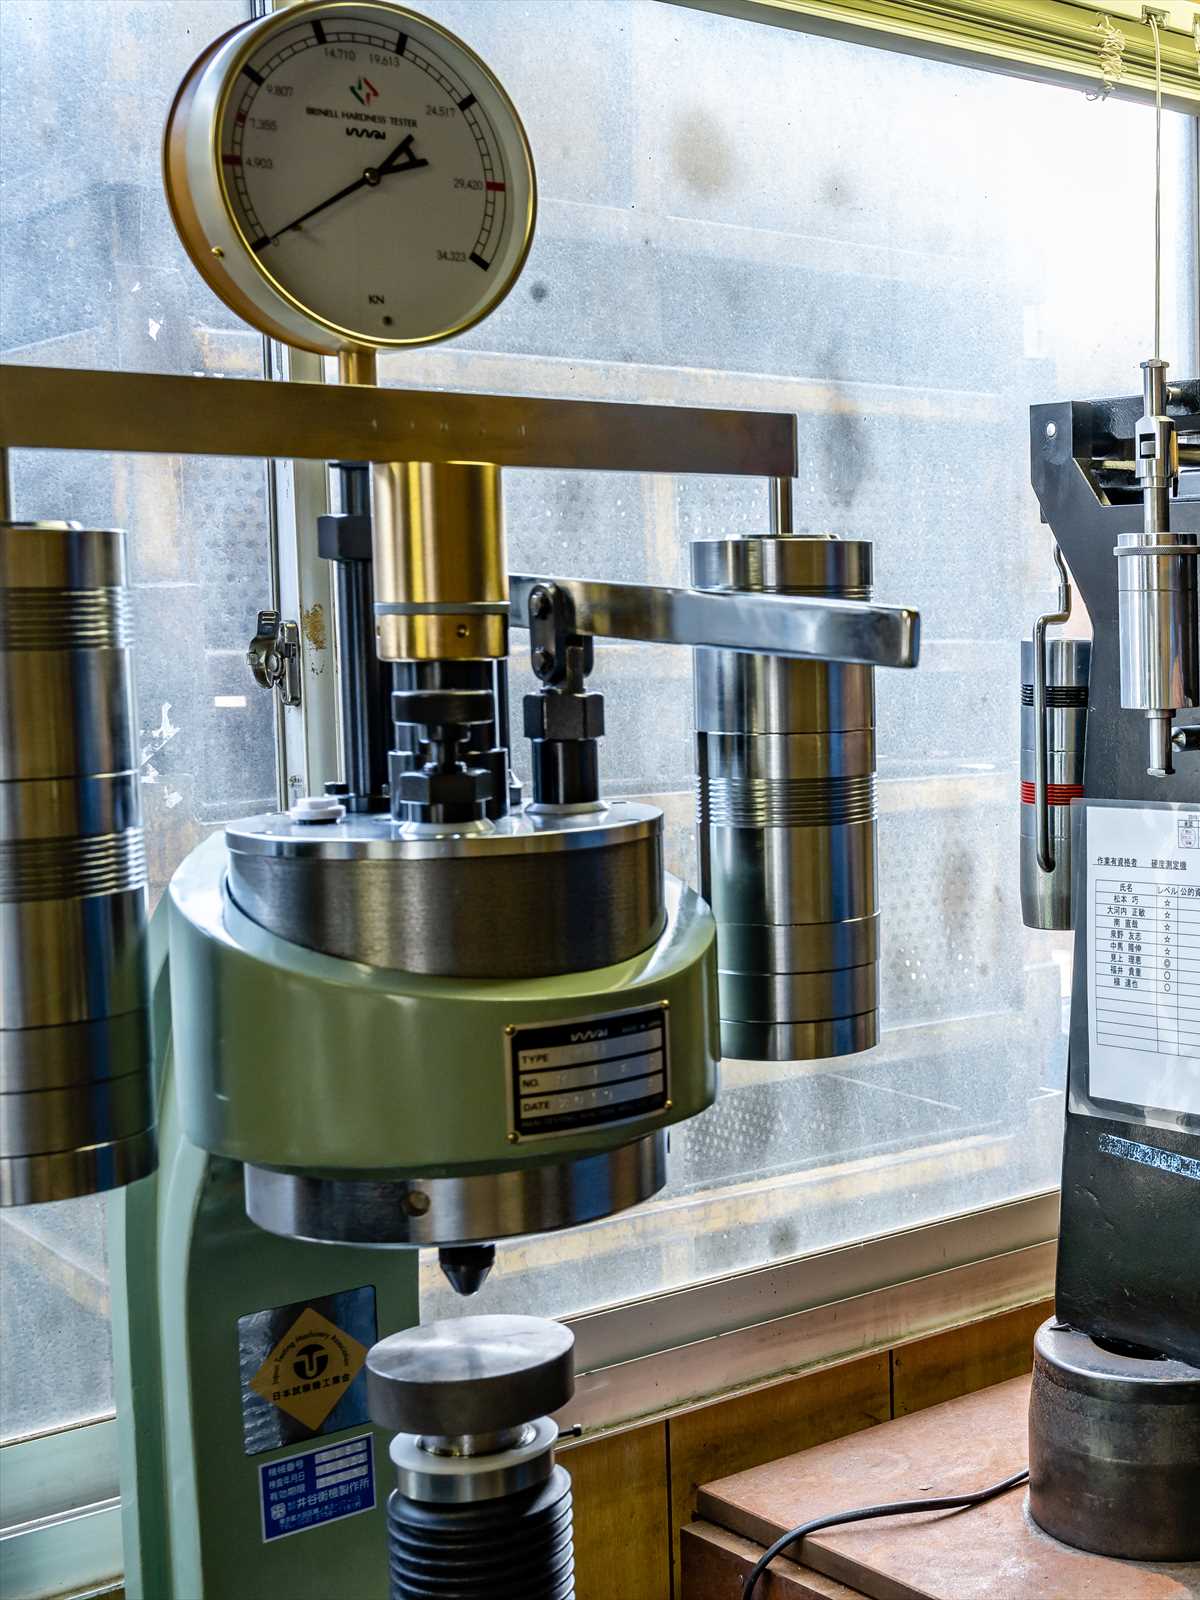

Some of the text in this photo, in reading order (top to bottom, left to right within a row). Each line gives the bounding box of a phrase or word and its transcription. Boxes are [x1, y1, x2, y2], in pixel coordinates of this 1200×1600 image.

[324, 48, 356, 62] 14.710
[369, 53, 400, 67] 19.613
[266, 84, 294, 98] 9.807
[425, 105, 457, 119] 24.517
[341, 110, 388, 125] HARDNESS
[390, 116, 418, 129] TESTER
[245, 158, 273, 170] 4.903
[453, 178, 484, 191] 29.420
[436, 250, 467, 263] 34.323
[368, 294, 385, 305] KN
[1097, 856, 1188, 871] 作業有資格者 硬度測定機
[1119, 883, 1133, 893] 氏名
[1158, 887, 1178, 895] レベル
[1113, 895, 1127, 904] 松本
[1107, 905, 1127, 916] 大河内
[521, 1052, 549, 1064] TYPE
[523, 1100, 550, 1112] DATE
